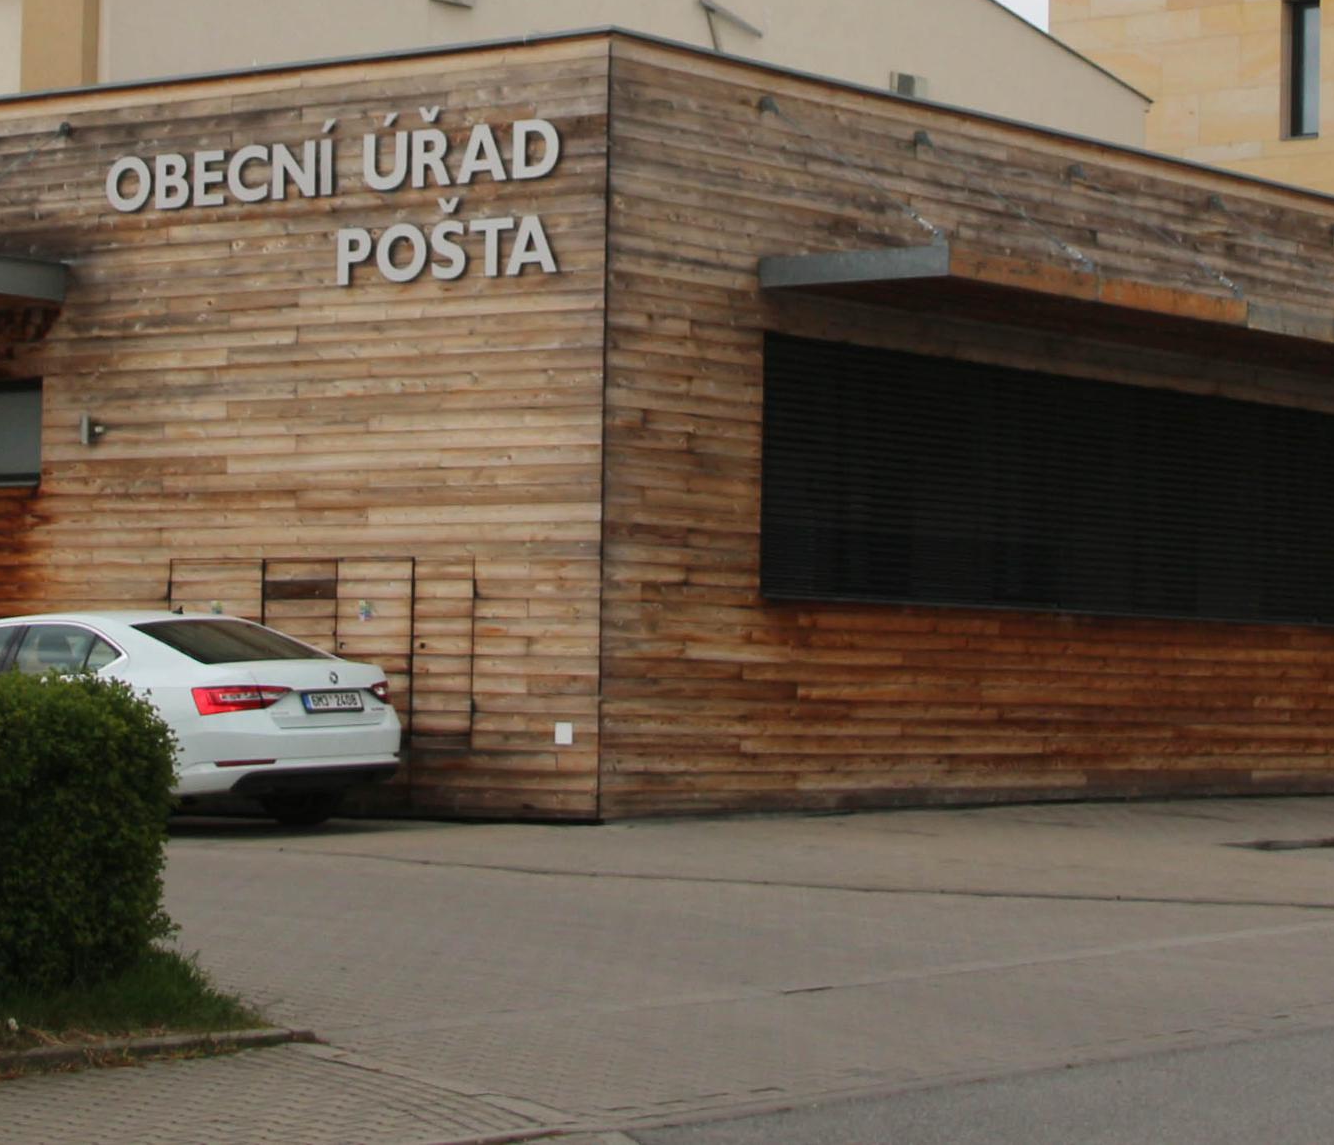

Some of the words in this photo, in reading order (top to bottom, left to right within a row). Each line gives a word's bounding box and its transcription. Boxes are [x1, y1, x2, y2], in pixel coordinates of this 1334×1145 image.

[105, 118, 338, 213] OBECNÍ
[363, 105, 561, 192] ÚŘAD
[336, 196, 557, 287] POŠTA
